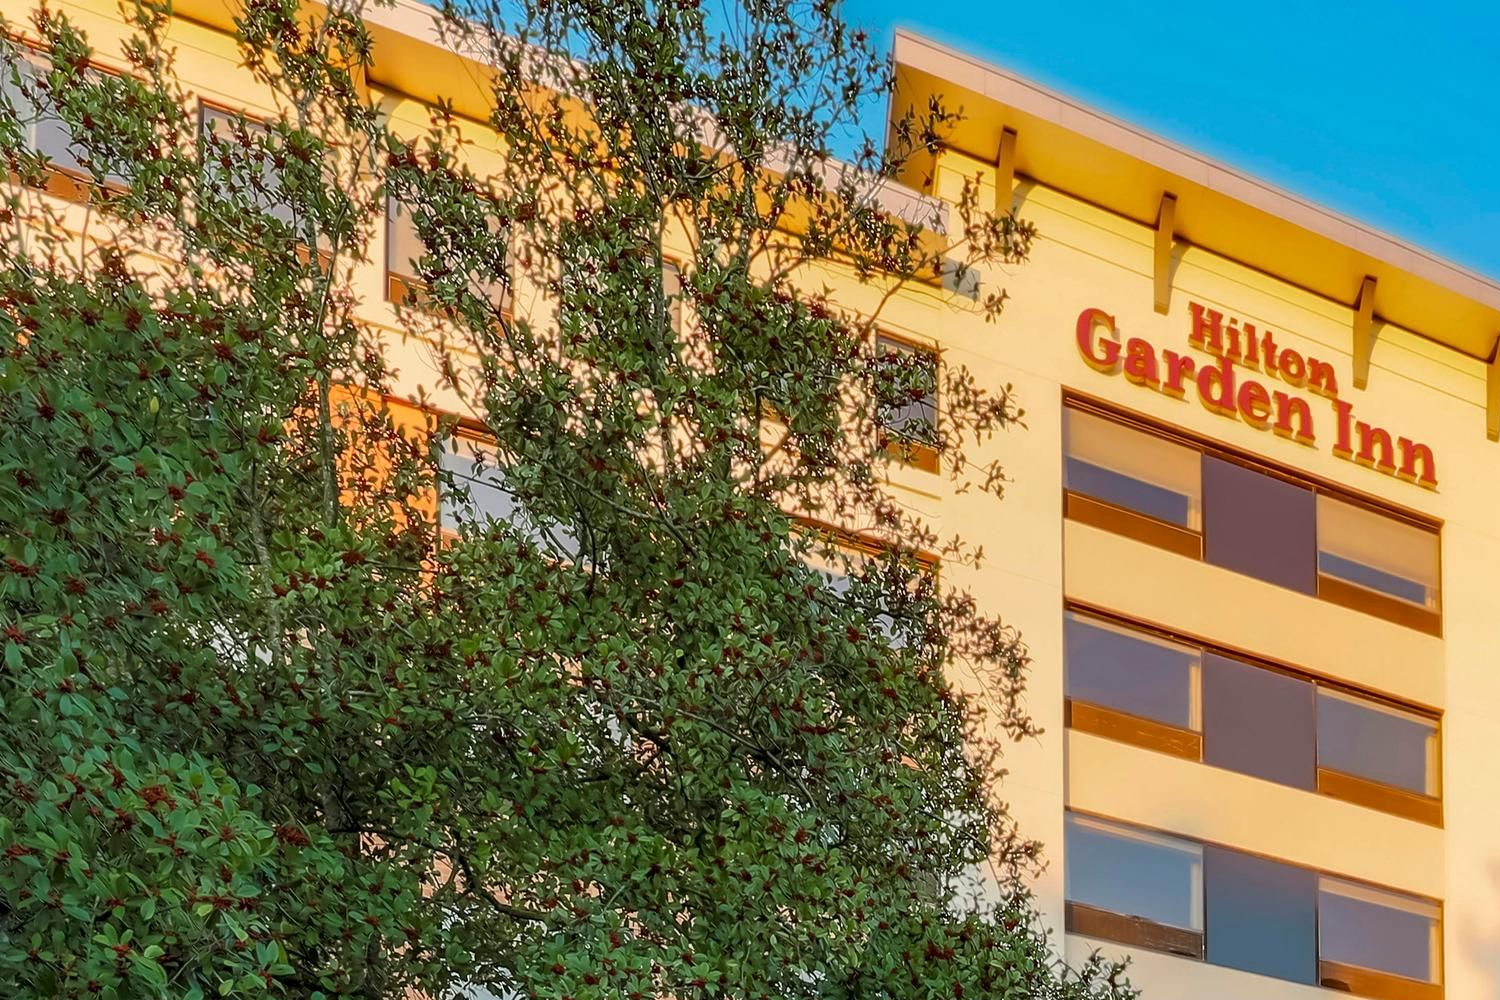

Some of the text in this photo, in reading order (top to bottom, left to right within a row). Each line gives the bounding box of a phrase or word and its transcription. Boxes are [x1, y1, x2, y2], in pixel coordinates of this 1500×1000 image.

[1076, 308, 1438, 489] Garden Inn
[1188, 301, 1338, 397] Hilton
